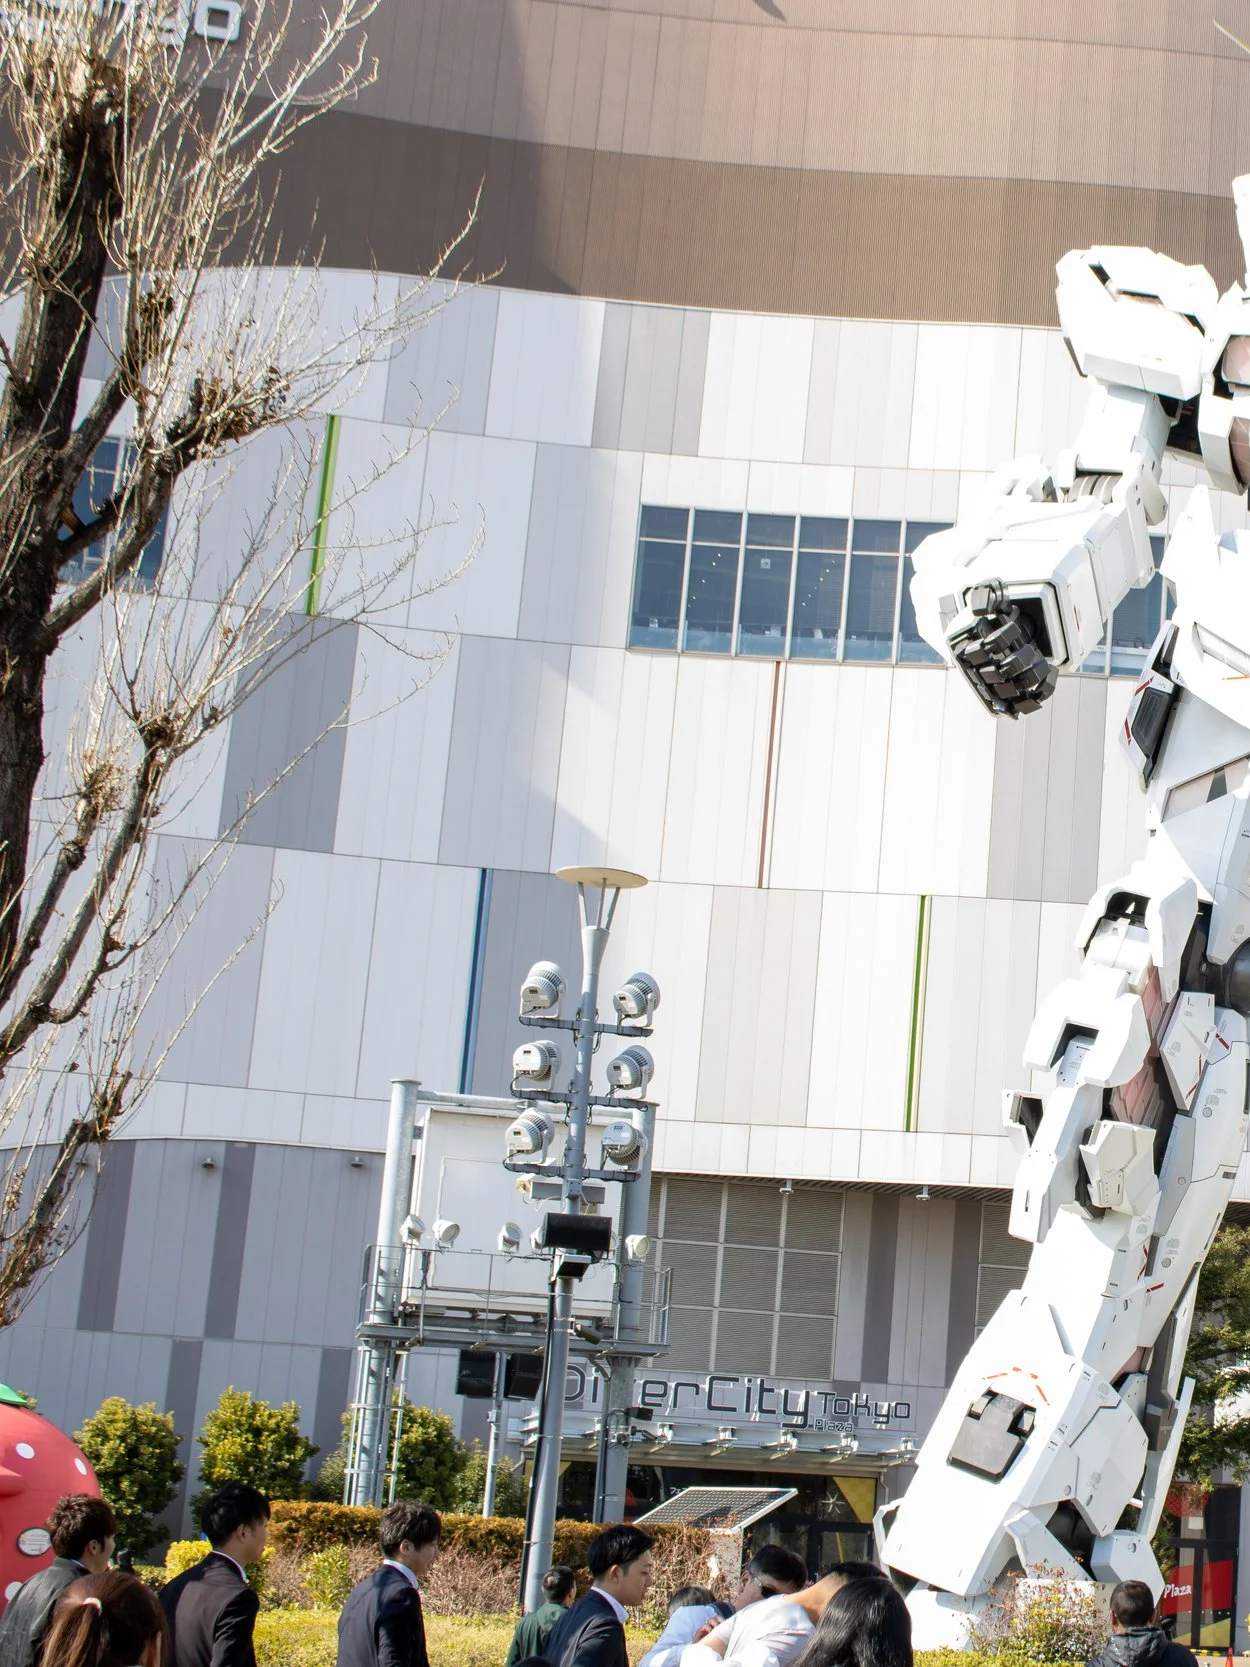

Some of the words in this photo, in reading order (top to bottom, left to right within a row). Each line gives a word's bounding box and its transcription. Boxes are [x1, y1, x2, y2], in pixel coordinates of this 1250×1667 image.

[563, 1363, 811, 1430] DierCity
[813, 1418, 854, 1433] Plaza
[1163, 1583, 1193, 1599] Plaza
